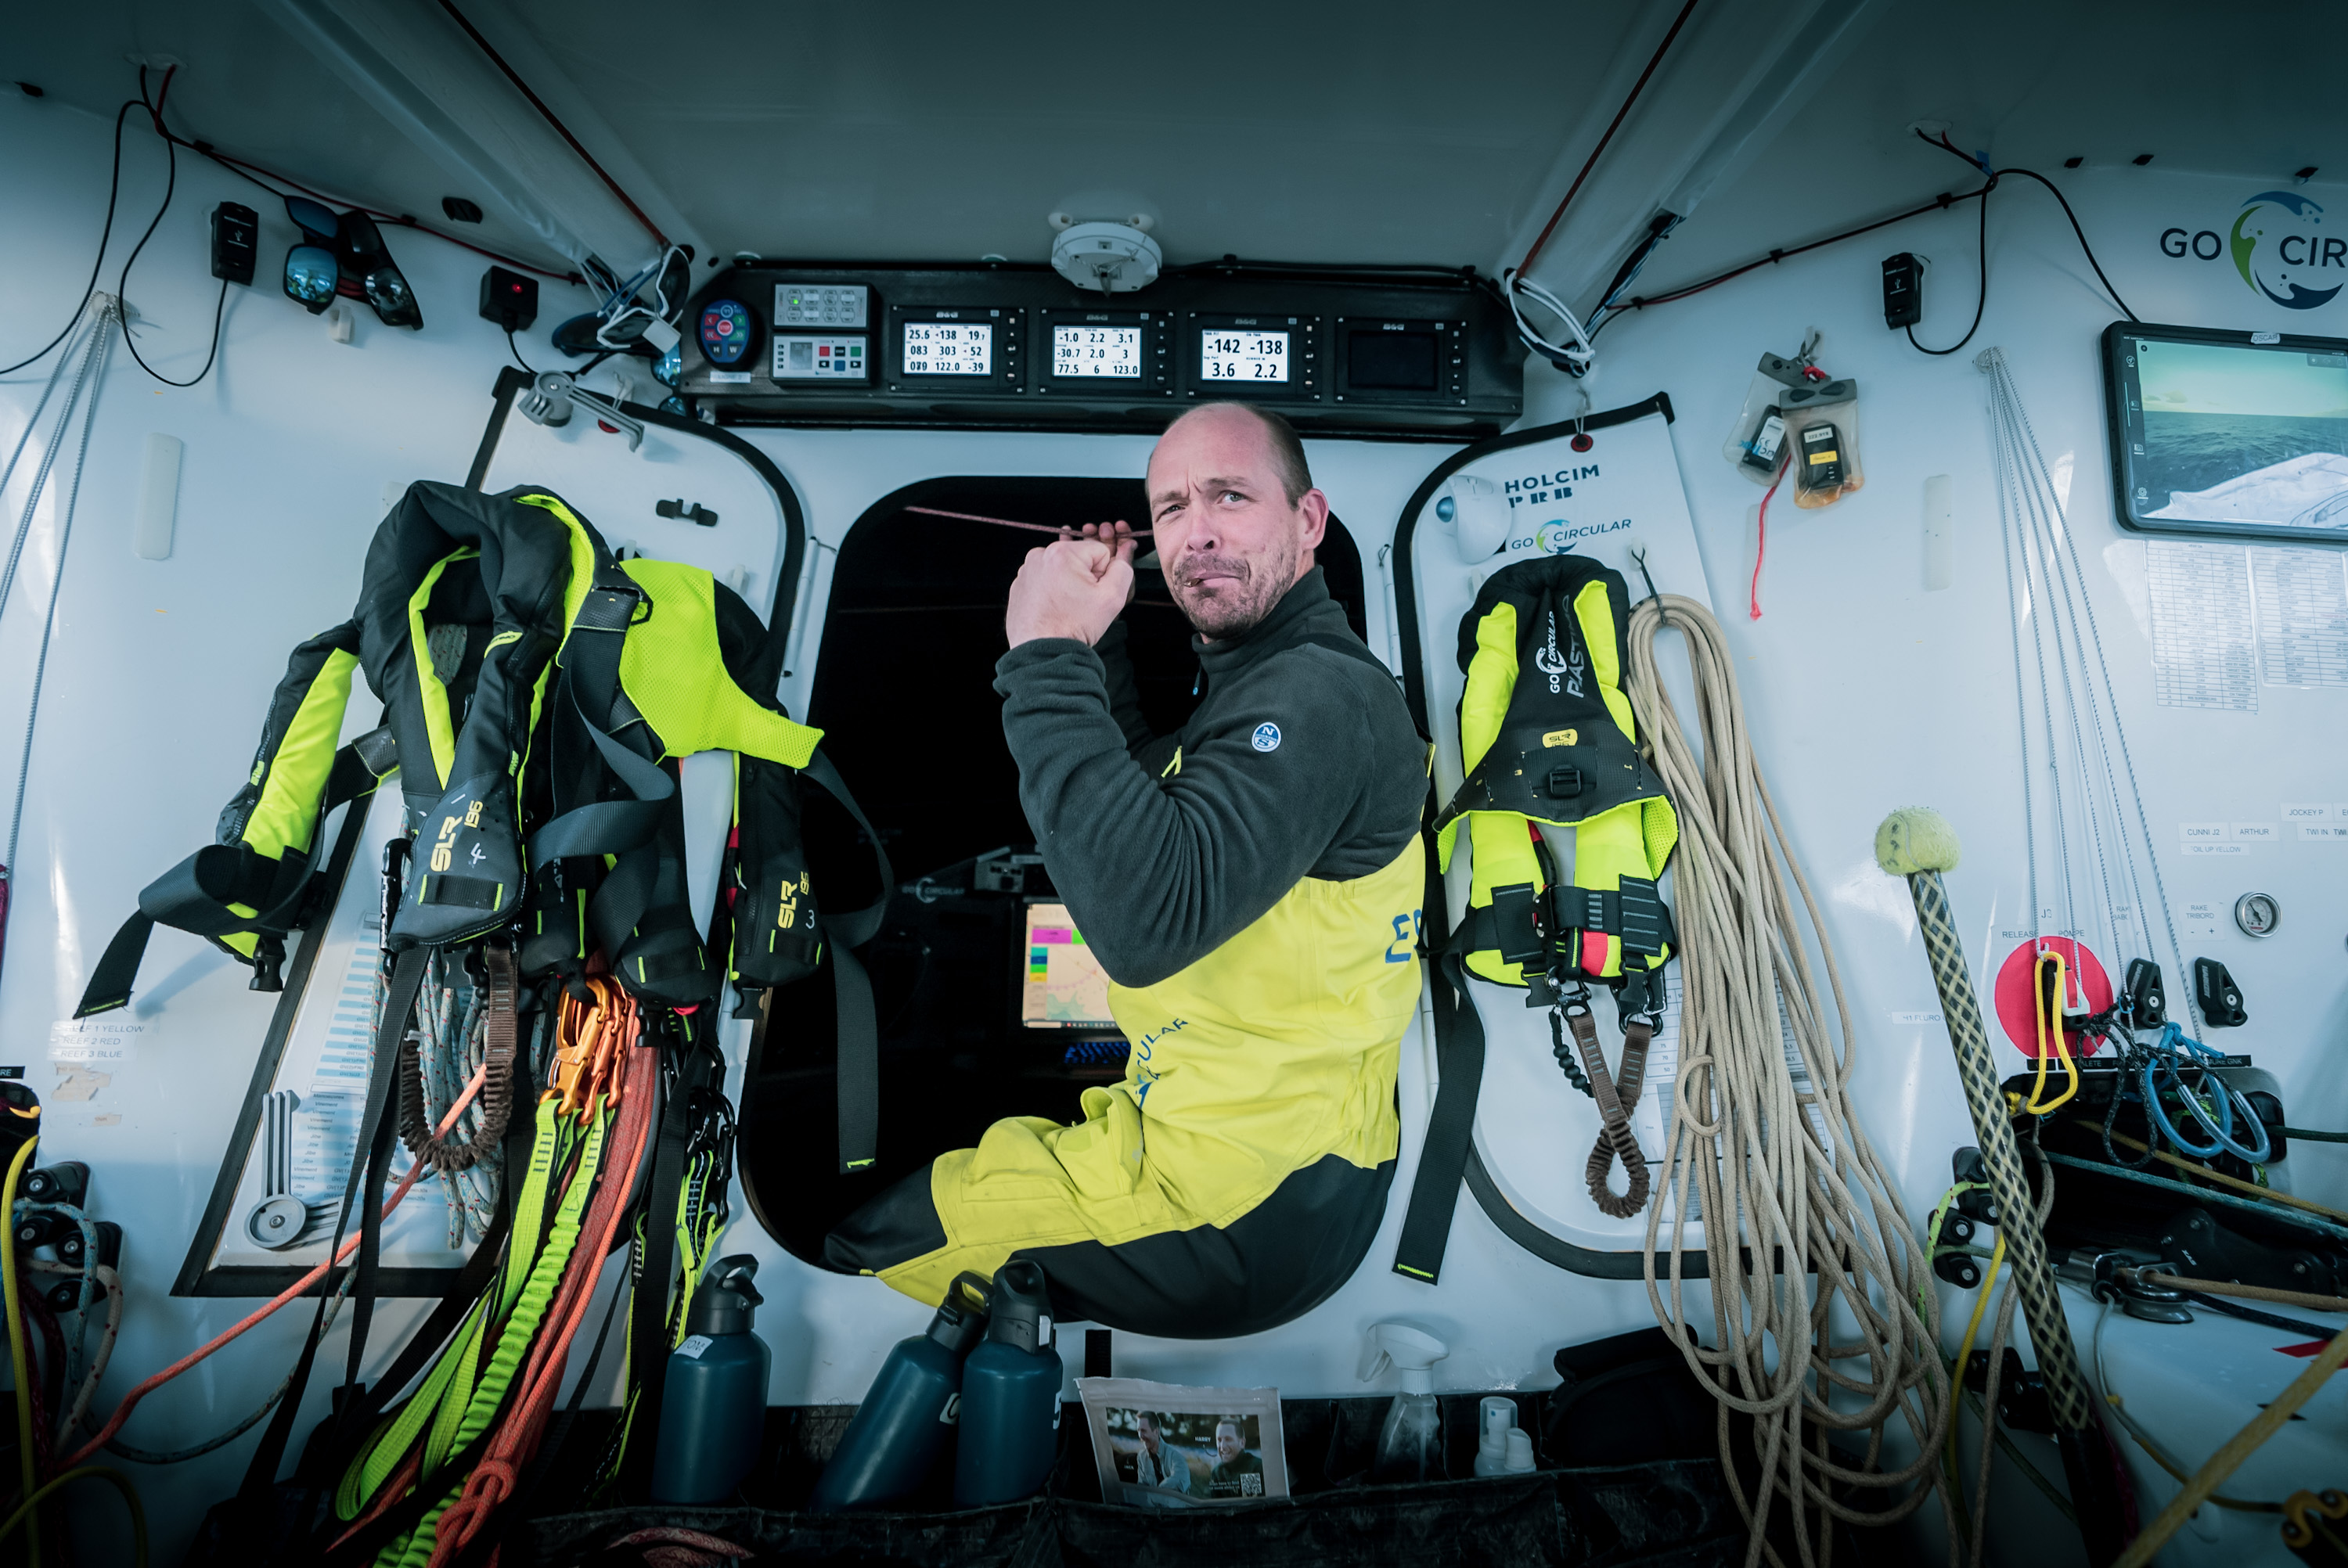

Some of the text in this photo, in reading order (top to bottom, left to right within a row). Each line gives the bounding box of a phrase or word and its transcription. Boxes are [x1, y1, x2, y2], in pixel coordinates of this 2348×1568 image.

[2160, 228, 2347, 268] GO CIR
[909, 329, 930, 340] 25.6
[940, 330, 956, 340] 138
[1060, 333, 1133, 343] -1.0 2.2 3.1
[910, 345, 981, 356] 083 303 52
[1057, 349, 1128, 358] -30.7 2.0 3
[1208, 339, 1282, 354] -142 -138
[935, 362, 960, 372] 122.0
[968, 362, 984, 372] -39
[1058, 365, 1137, 374] 77.5 6 123.0
[1212, 362, 1277, 378] 3.6 2.2
[1504, 464, 1600, 494] HOLCIM
[1508, 487, 1572, 508] PRB
[1511, 519, 1631, 549] GO CIRCULAR
[1550, 674, 1560, 693] GO
[1262, 726, 1275, 735] N
[1549, 733, 1571, 742] SLR
[464, 800, 483, 828] 196
[430, 815, 463, 872] SLR
[470, 843, 486, 865] 4
[778, 880, 798, 929] SLR
[805, 909, 815, 929] 3
